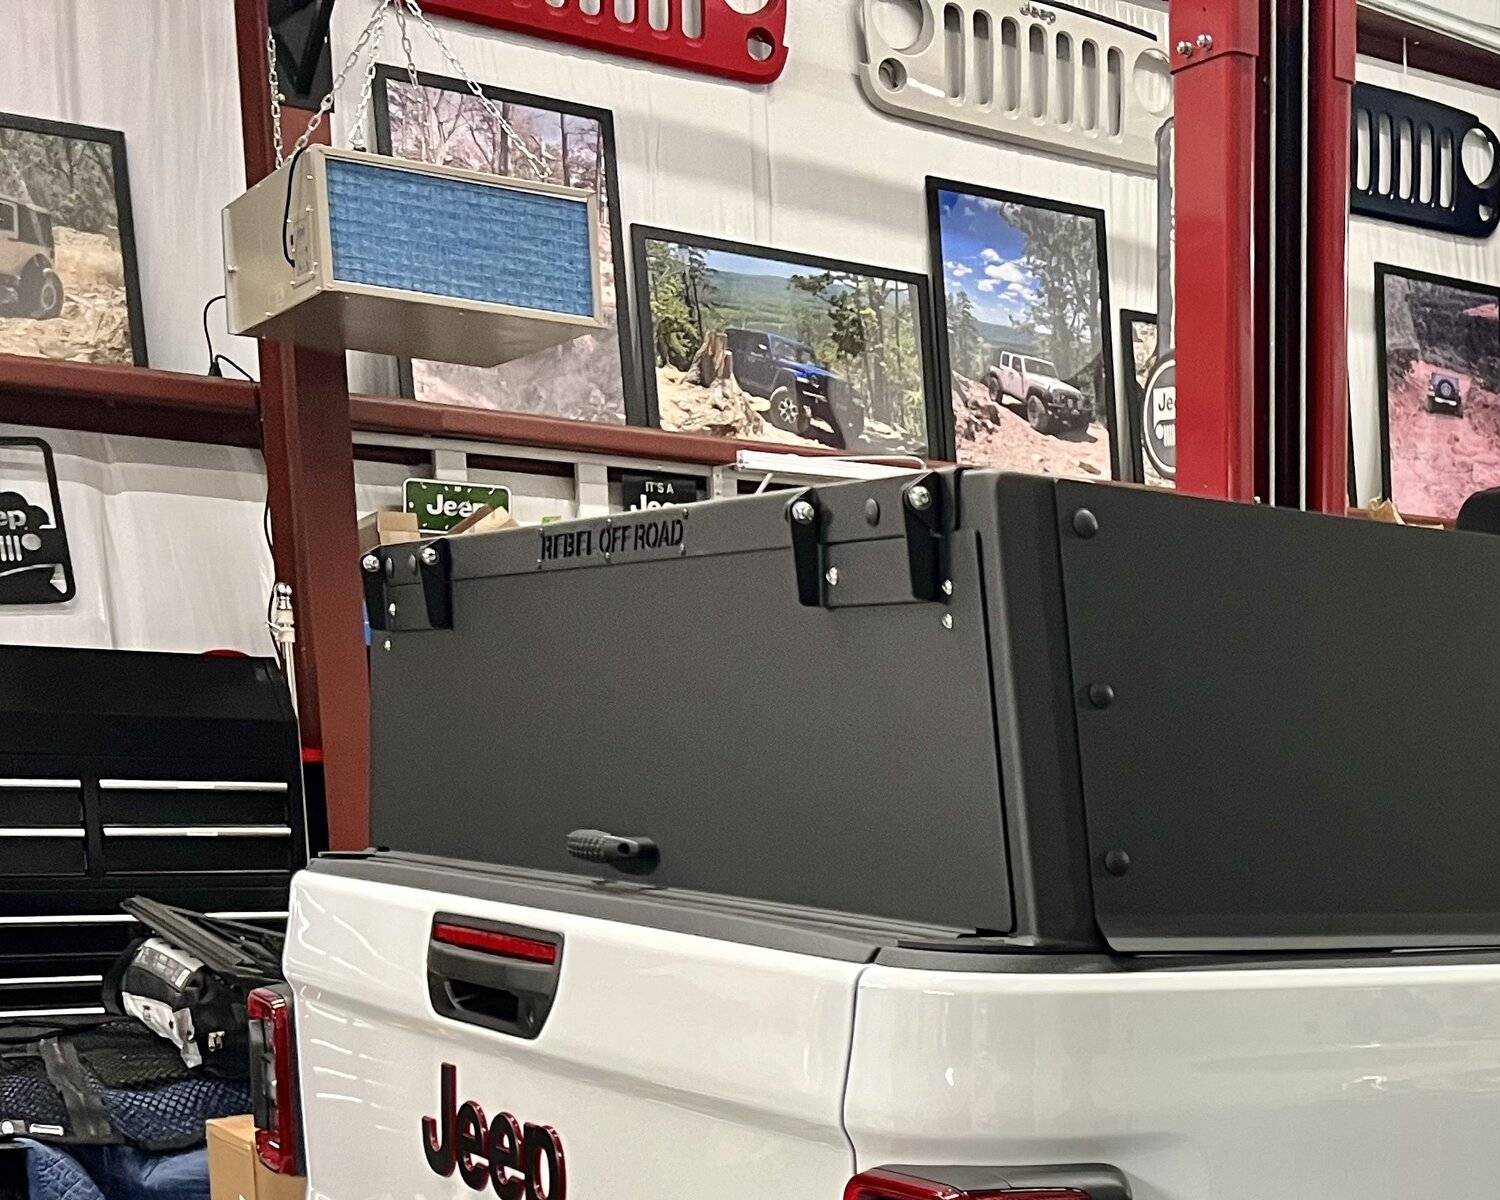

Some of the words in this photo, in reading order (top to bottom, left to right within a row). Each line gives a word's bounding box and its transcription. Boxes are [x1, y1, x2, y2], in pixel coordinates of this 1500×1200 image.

[1019, 1, 1056, 25] Jeep
[1158, 392, 1174, 412] Je
[666, 483, 675, 494] A
[599, 525, 632, 553] OFF
[634, 519, 684, 550] ROAD
